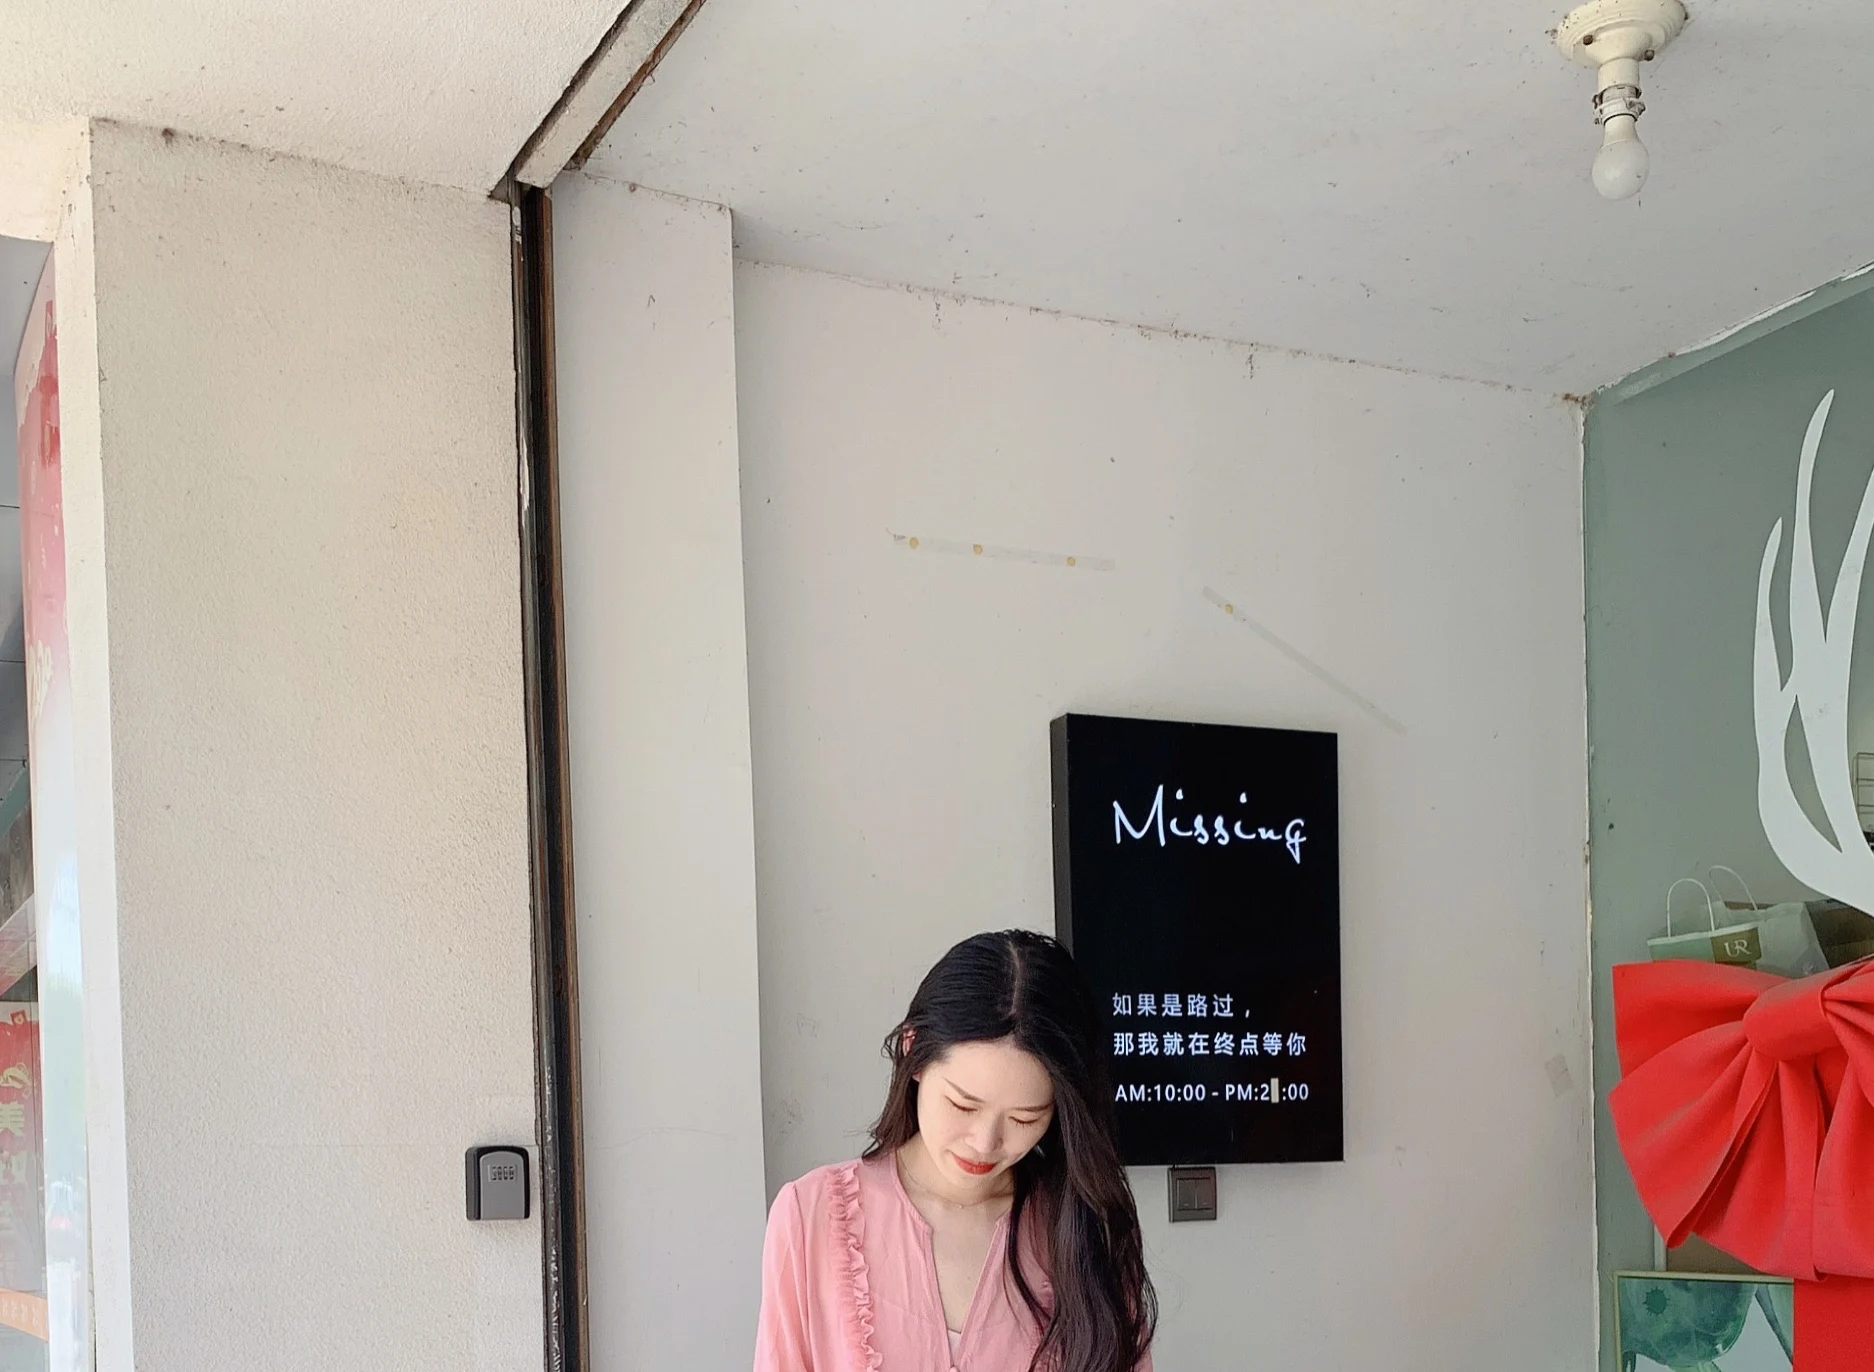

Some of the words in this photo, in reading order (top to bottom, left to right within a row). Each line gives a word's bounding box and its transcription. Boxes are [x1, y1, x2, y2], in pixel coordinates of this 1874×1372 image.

[1112, 784, 1307, 864] Missing
[1723, 939, 1752, 957] UR
[1112, 992, 1251, 1019] 如果是路过，
[1113, 1031, 1307, 1057] 那我就在终点等你
[1115, 1084, 1206, 1102] AM:10:00
[1225, 1083, 1310, 1101] PM:2:00
